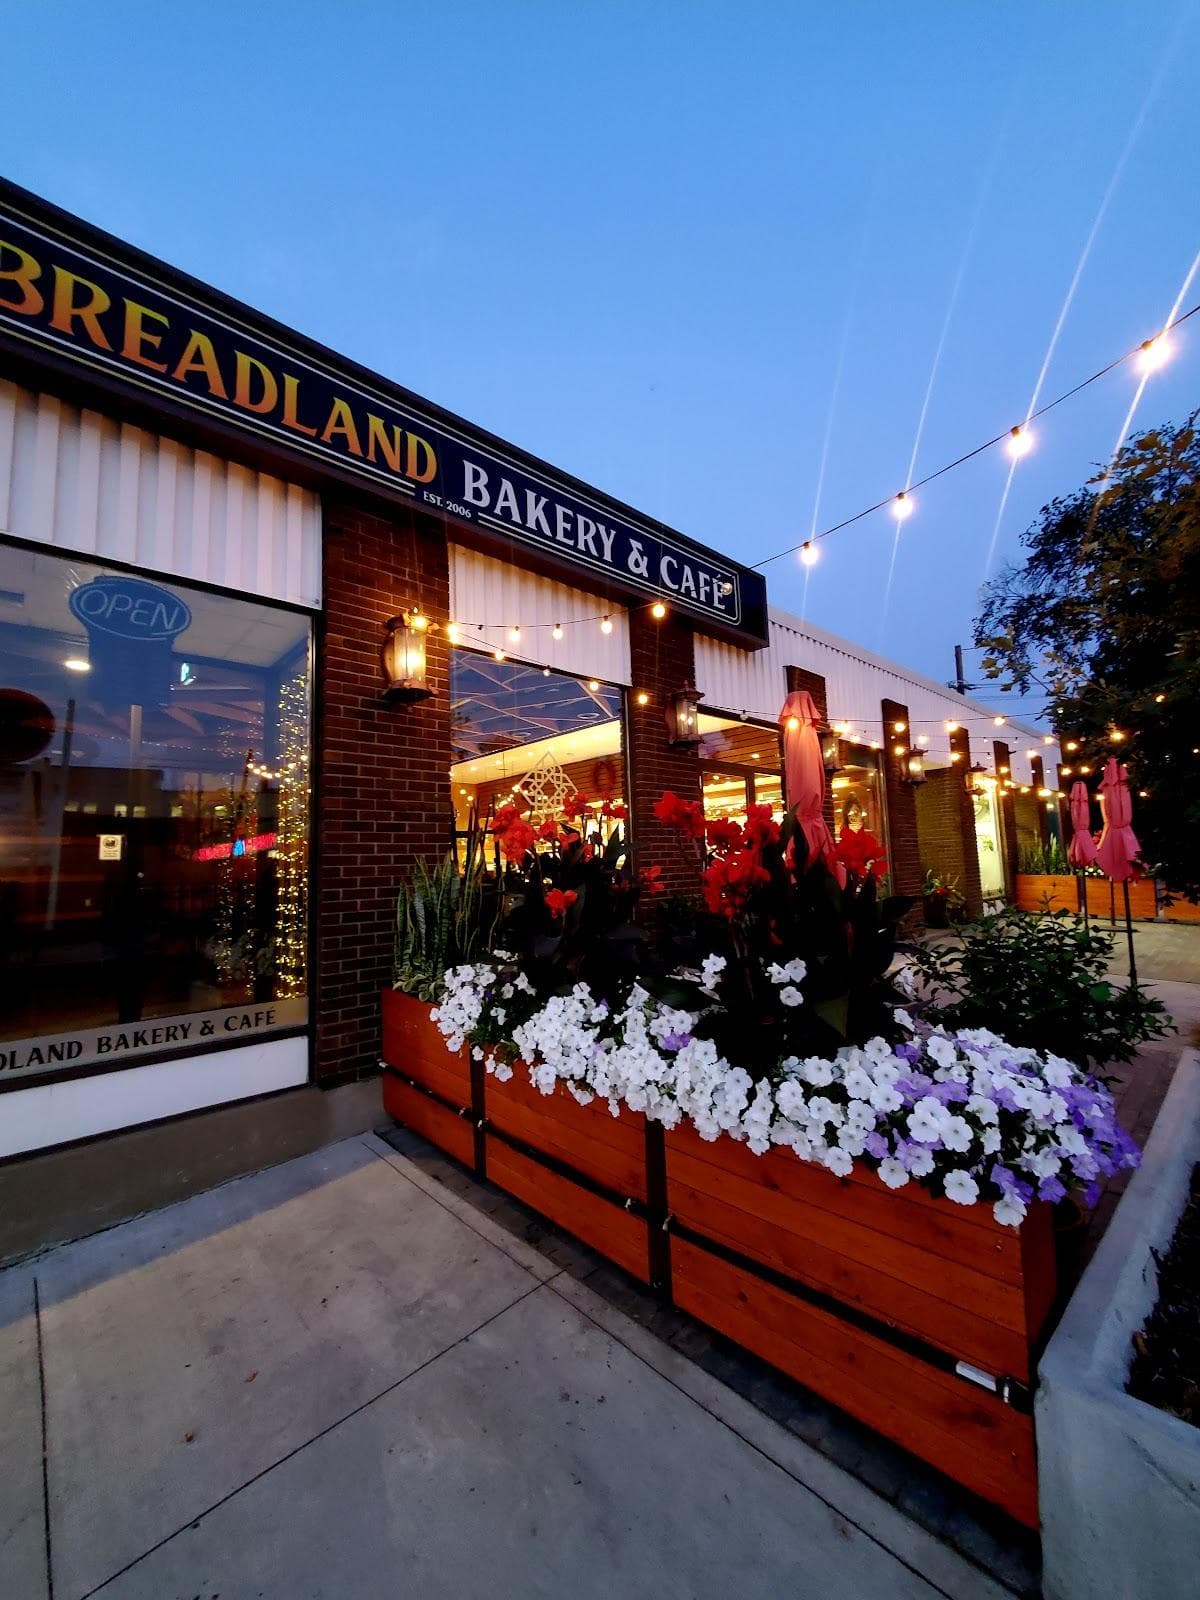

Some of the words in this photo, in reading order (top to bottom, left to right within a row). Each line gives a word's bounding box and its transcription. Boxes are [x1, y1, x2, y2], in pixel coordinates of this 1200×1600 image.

[0, 239, 438, 484] BREADLAND
[462, 459, 616, 562] BAKERY
[627, 538, 649, 578] &
[660, 555, 726, 610] CAFÉ
[423, 491, 443, 507] EST.
[446, 501, 471, 518] 2006
[80, 588, 180, 631] OPEN
[96, 1022, 192, 1055] BAKERY
[199, 1019, 215, 1036] &
[223, 1007, 277, 1032] CAFÉ
